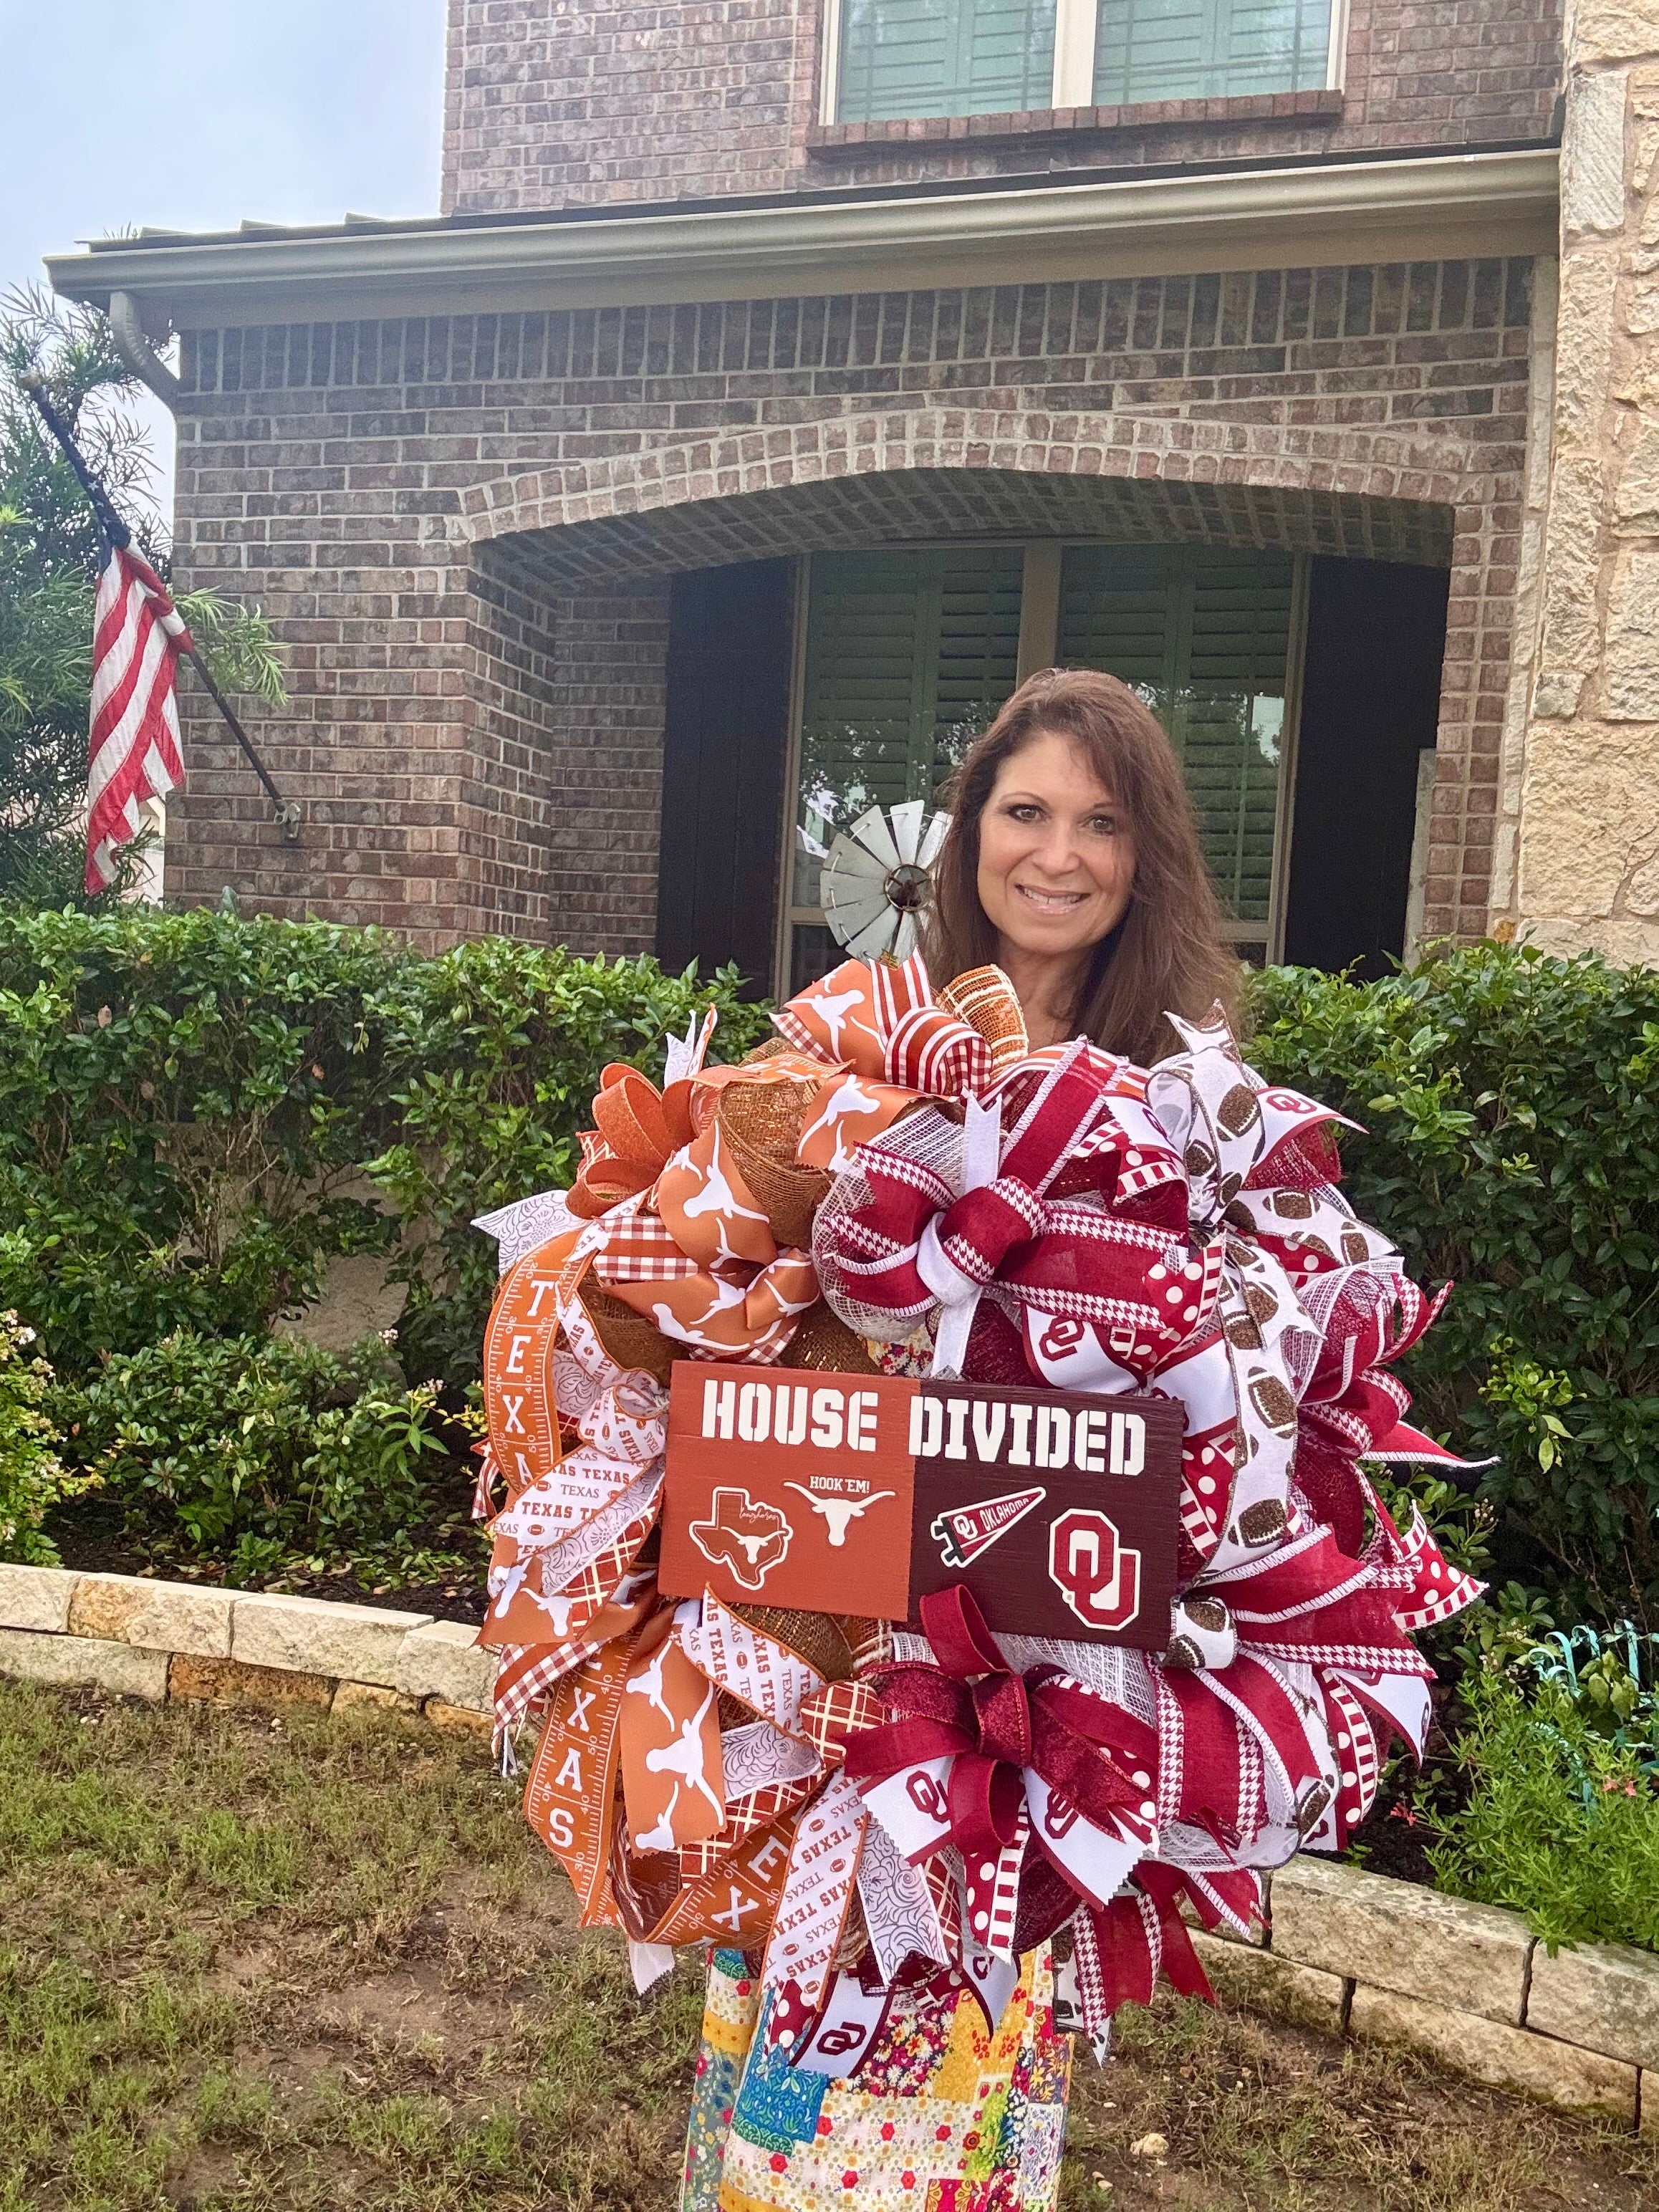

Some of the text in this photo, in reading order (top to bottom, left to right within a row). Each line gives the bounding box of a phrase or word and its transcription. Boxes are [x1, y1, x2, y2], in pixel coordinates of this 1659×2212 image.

[1266, 1094, 1317, 1114] OU
[701, 1379, 879, 1452] HOUSE
[908, 1395, 1146, 1476] DIVIDED
[560, 1484, 600, 1499] TEXAS
[582, 1468, 630, 1484] TEXAS
[809, 1476, 870, 1494] HOOK 'EM!
[522, 1501, 573, 1519] TEXAS
[953, 1514, 978, 1539] OU
[1050, 1509, 1140, 1630] OU
[708, 1627, 728, 1683] TEXAS
[761, 1679, 776, 1721] TEX
[782, 1668, 793, 1711] TEXAS
[801, 1826, 852, 1864] TEXAS
[785, 1872, 824, 1903] TEXAS
[817, 2021, 867, 2056] OU
